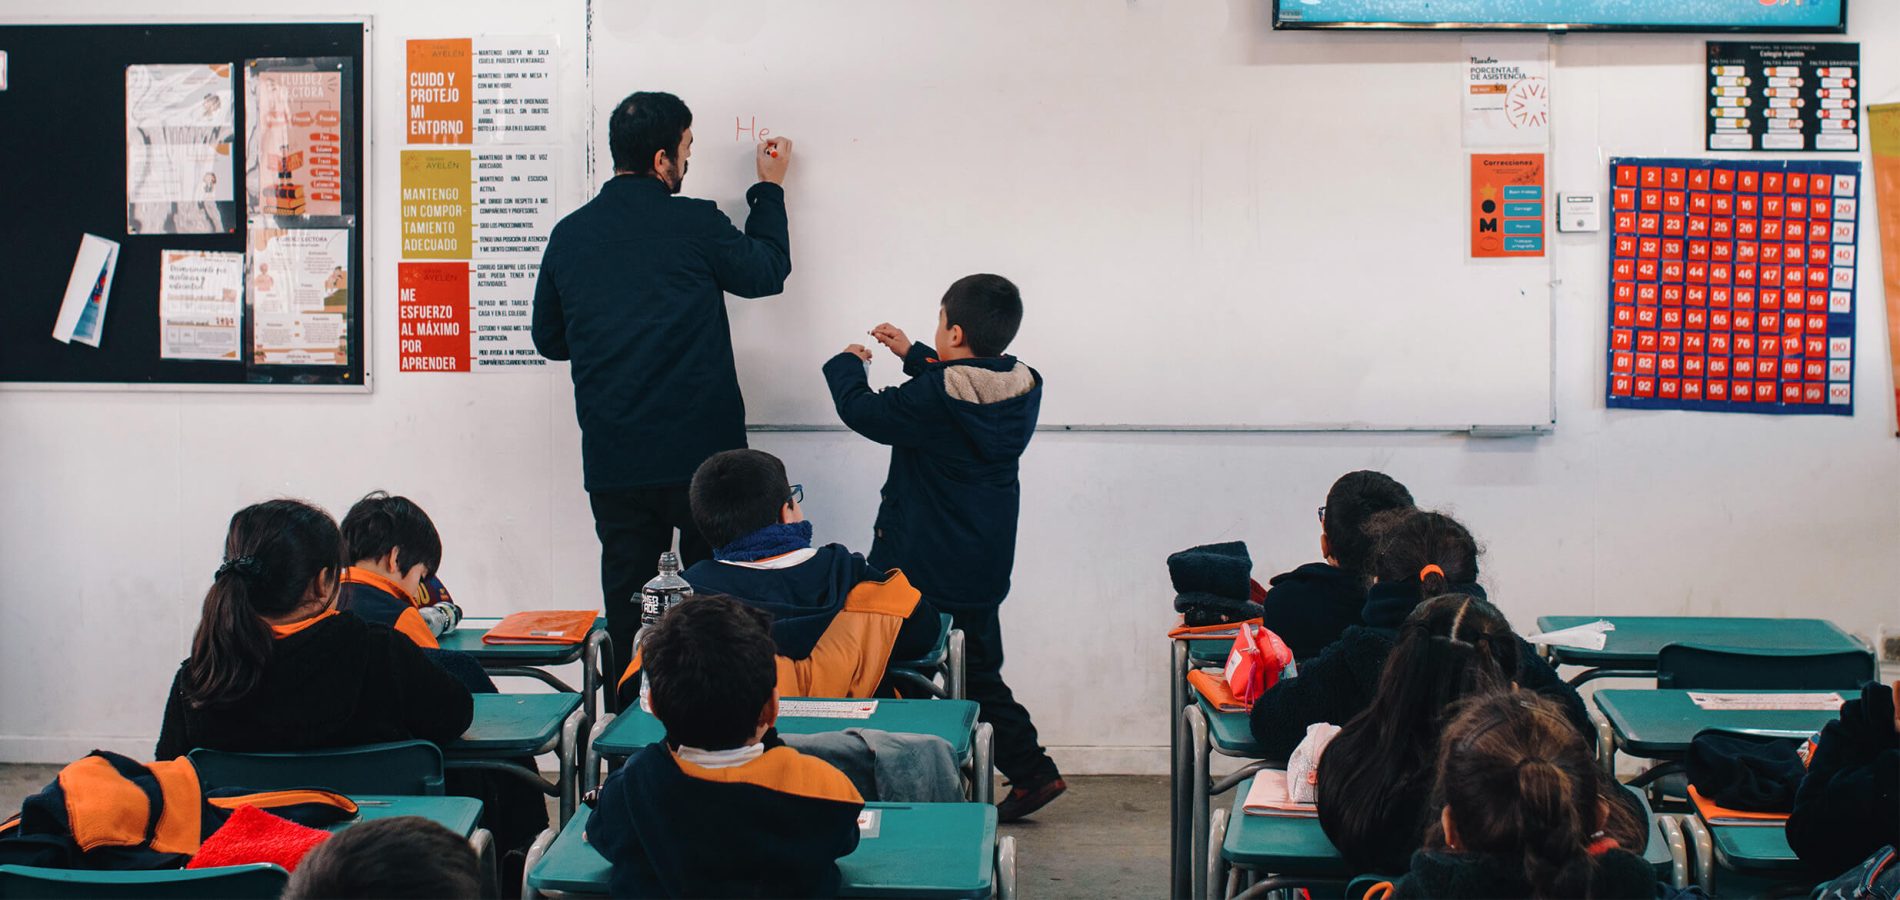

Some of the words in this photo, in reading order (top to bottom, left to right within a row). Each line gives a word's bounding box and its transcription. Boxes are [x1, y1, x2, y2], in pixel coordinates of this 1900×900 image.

[410, 72, 444, 86] CUIDO
[448, 72, 455, 86] Y
[410, 88, 459, 103] PROTEJO
[411, 105, 424, 119] MI
[411, 120, 464, 135] ENTORNO
[1624, 170, 1629, 180] 1
[1648, 172, 1655, 182] 2
[1671, 172, 1679, 182] 3
[1695, 175, 1703, 183] 4
[1720, 174, 1727, 184] 5
[1744, 176, 1752, 186] 6
[1770, 177, 1777, 186] 7
[1793, 178, 1801, 188] 8
[1817, 179, 1825, 189] 9
[1839, 181, 1849, 189] 10
[403, 188, 458, 200] MANTENGO
[404, 205, 416, 217] UN
[420, 205, 467, 216] COMPOR-
[1621, 194, 1628, 202] 11
[1647, 194, 1656, 204] 12
[1669, 196, 1679, 206] 13
[1695, 198, 1704, 207] 14
[1717, 200, 1727, 209] 15
[1742, 200, 1752, 210] 16
[1768, 201, 1778, 210] 17
[1791, 202, 1801, 212] 18
[1816, 203, 1826, 212] 19
[1838, 204, 1851, 213] 20
[404, 222, 455, 234] TAMIENTO
[1480, 218, 1497, 232] M
[1620, 217, 1630, 227] 21
[1642, 218, 1654, 228] 22
[1667, 220, 1680, 229] 23
[1691, 220, 1704, 230] 24
[1715, 222, 1727, 232] 25
[1740, 223, 1752, 232] 26
[1764, 224, 1777, 233] 27
[1788, 225, 1801, 234] 28
[1812, 226, 1826, 235] 29
[1837, 228, 1850, 236] 30
[404, 239, 457, 251] ADECUADO
[1621, 241, 1631, 250] 31
[1643, 242, 1655, 252] 32
[1666, 243, 1678, 253] 33
[1692, 245, 1704, 254] 34
[1715, 246, 1728, 255] 35
[1740, 246, 1753, 256] 36
[1764, 248, 1777, 257] 37
[1788, 248, 1800, 258] 38
[1812, 249, 1825, 258] 39
[1837, 251, 1850, 260] 40
[1618, 265, 1628, 273] 41
[1640, 265, 1653, 274] 42
[1666, 266, 1679, 276] 43
[1690, 268, 1702, 276] 44
[1713, 269, 1726, 278] 45
[1738, 270, 1752, 279] 46
[1764, 270, 1776, 280] 47
[1788, 272, 1800, 281] 48
[1810, 272, 1824, 281] 49
[1836, 273, 1849, 282] 50
[401, 288, 416, 301] ME
[1619, 287, 1629, 296] 51
[1641, 288, 1654, 298] 52
[1665, 290, 1678, 299] 53
[1689, 290, 1702, 299] 54
[1714, 291, 1726, 301] 55
[1737, 292, 1750, 302] 56
[1763, 294, 1776, 303] 57
[1788, 293, 1800, 302] 58
[1810, 295, 1823, 305] 59
[1832, 297, 1846, 306] 60
[401, 305, 452, 318] ESFUERZO
[1619, 310, 1629, 320] 61
[1640, 311, 1652, 321] 62
[1665, 312, 1678, 322] 63
[1688, 314, 1702, 322] 64
[1713, 315, 1726, 324] 65
[1736, 317, 1749, 326] 66
[1762, 316, 1775, 326] 67
[1787, 318, 1800, 327] 68
[1809, 319, 1822, 328] 69
[401, 323, 413, 336] AL
[417, 320, 460, 335] MÁXIMO
[402, 340, 422, 353] POR
[1617, 334, 1626, 343] 71
[1642, 336, 1653, 345] 72
[1664, 336, 1675, 346] 73
[1688, 337, 1700, 346] 74
[1713, 338, 1725, 348] 75
[1738, 338, 1750, 348] 76
[1762, 340, 1775, 349] 77
[1785, 338, 1798, 349] 78
[1809, 342, 1822, 351] 79
[1832, 344, 1846, 352] 80
[402, 357, 456, 370] APRENDER
[1618, 357, 1628, 366] 81
[1638, 358, 1652, 368] 82
[1662, 359, 1674, 368] 83
[1686, 360, 1700, 369] 84
[1711, 362, 1724, 370] 85
[1736, 362, 1750, 371] 86
[1760, 362, 1773, 372] 87
[1785, 363, 1798, 373] 88
[1808, 365, 1821, 374] 89
[1833, 366, 1845, 374] 90
[1617, 380, 1627, 389] 91
[1638, 381, 1650, 390] 92
[1662, 382, 1675, 392] 93
[1685, 384, 1698, 393] 94
[1710, 384, 1723, 394] 95
[1735, 386, 1748, 395] 96
[1759, 386, 1772, 395] 97
[1786, 387, 1798, 396] 98
[1807, 389, 1820, 398] 99
